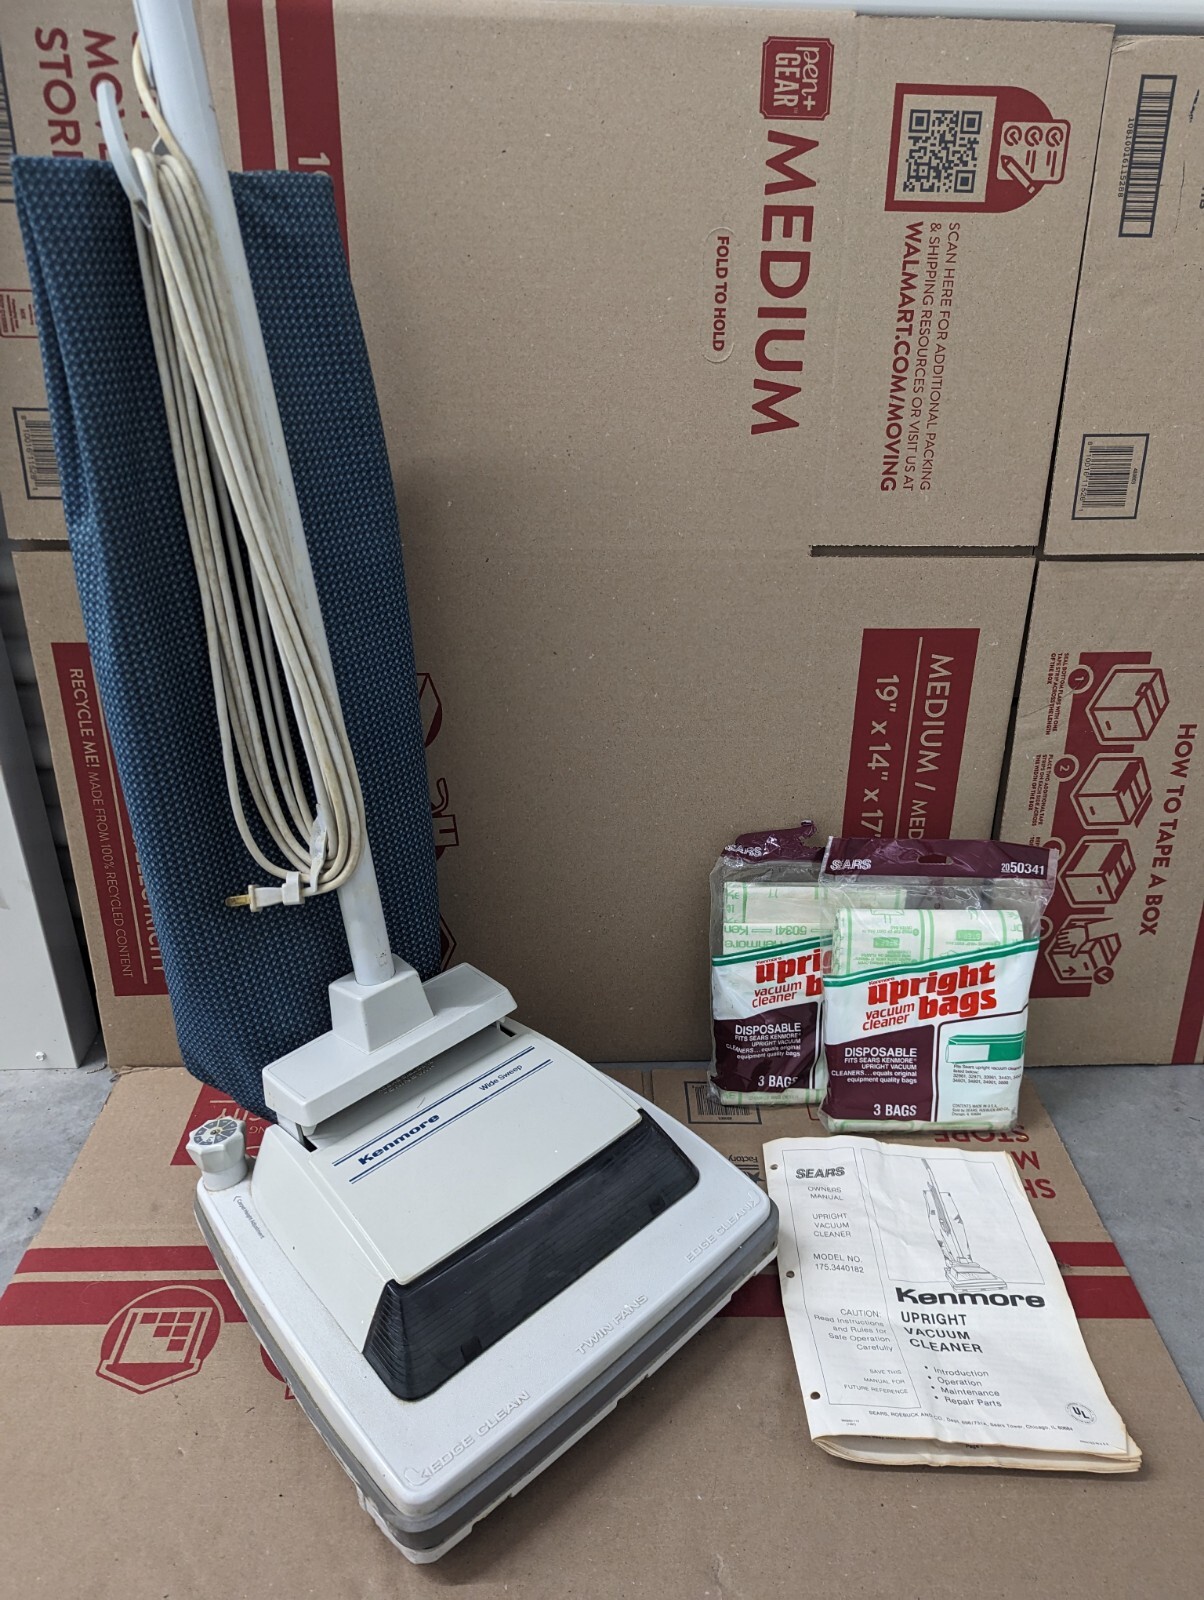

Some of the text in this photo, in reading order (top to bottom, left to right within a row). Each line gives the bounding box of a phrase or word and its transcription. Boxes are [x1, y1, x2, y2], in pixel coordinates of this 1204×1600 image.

[773, 53, 801, 107] GEAR
[751, 130, 819, 435] MEDIUM
[712, 236, 729, 351] FOLD TO HOLD
[880, 221, 923, 492] WALMART.COM/MOVING
[902, 222, 942, 491] & SHIPPING RESOURCES OR VISIT US AT
[920, 222, 960, 491] SCAN HERE FOR ADDITIONAL PACKING
[916, 654, 954, 773] MEDIUM
[870, 720, 888, 735] x
[863, 788, 879, 802] x
[69, 668, 134, 978] RECYCLE ME! MADE FROM 100% RECYCLED CONTENT
[908, 799, 928, 840] MED
[1139, 724, 1197, 935] HOW TO TAPE A BOX
[724, 925, 807, 935] 50341 Ken
[755, 949, 821, 984] upri
[754, 980, 802, 998] vacuum
[867, 961, 996, 1005] upright
[752, 991, 797, 1008] cleaner
[918, 988, 997, 1020] bags
[865, 1002, 915, 1020] vacuum
[735, 1023, 801, 1035] DISPOSABLE
[862, 1013, 911, 1031] cleaner
[736, 1052, 766, 1060] equipment
[844, 1046, 917, 1058] DISPOSABLE
[479, 1064, 523, 1091] Wide Sweep
[758, 1075, 764, 1086] 3
[873, 1104, 917, 1116] 3 BAGS
[358, 1113, 440, 1165] Kenmore
[728, 1154, 758, 1163] Factory
[795, 1166, 845, 1179] SEARS
[685, 1203, 753, 1263] EDGE CLEAN
[813, 1253, 862, 1263] MODEL NO.
[895, 1287, 1046, 1308] Kenmore
[813, 1314, 885, 1327] Read Instructions
[840, 1308, 881, 1318] CAUTION:
[900, 1311, 967, 1326] UPRIGHT
[575, 1294, 649, 1355] TWIN FANS
[850, 1326, 873, 1334] Rules
[828, 1332, 890, 1343] Safe Operation
[903, 1327, 971, 1340] VACUUM
[856, 1343, 893, 1352] Carefully
[909, 1338, 983, 1353] CLEANER
[933, 1366, 989, 1377] Introduction
[937, 1376, 983, 1387] Operation
[940, 1386, 1001, 1397] Maintenance
[944, 1396, 1002, 1408] Repair Parts
[1072, 1406, 1090, 1419] UL
[430, 1390, 531, 1475] EDGE CLEAN
